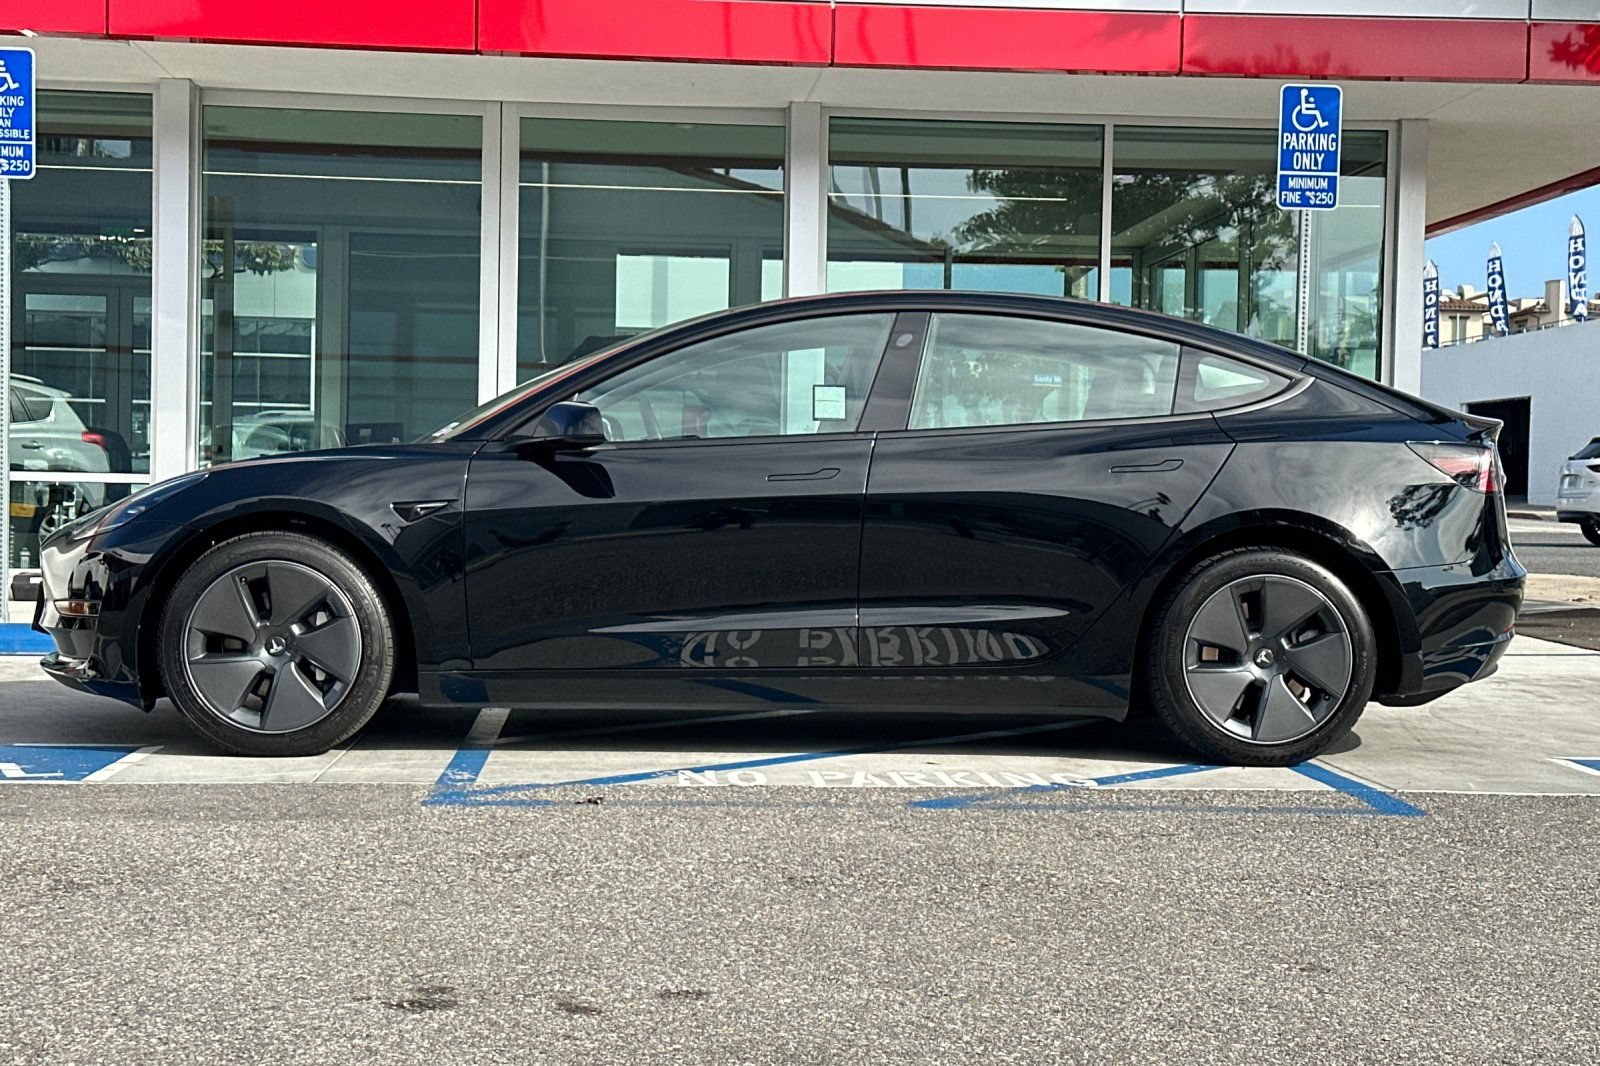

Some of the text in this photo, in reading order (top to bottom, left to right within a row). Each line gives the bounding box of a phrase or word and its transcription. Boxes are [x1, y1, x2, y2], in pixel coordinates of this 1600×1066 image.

[0, 96, 24, 106] KING
[0, 118, 11, 128] AN
[0, 129, 30, 138] SSIBLE
[1283, 132, 1336, 151] PARKING
[1, 146, 24, 157] MUM
[1293, 151, 1325, 170] ONLY
[1288, 177, 1329, 190] MINIMUM
[1281, 191, 1334, 205] FINE $250
[678, 769, 1099, 787] NO PARKING
